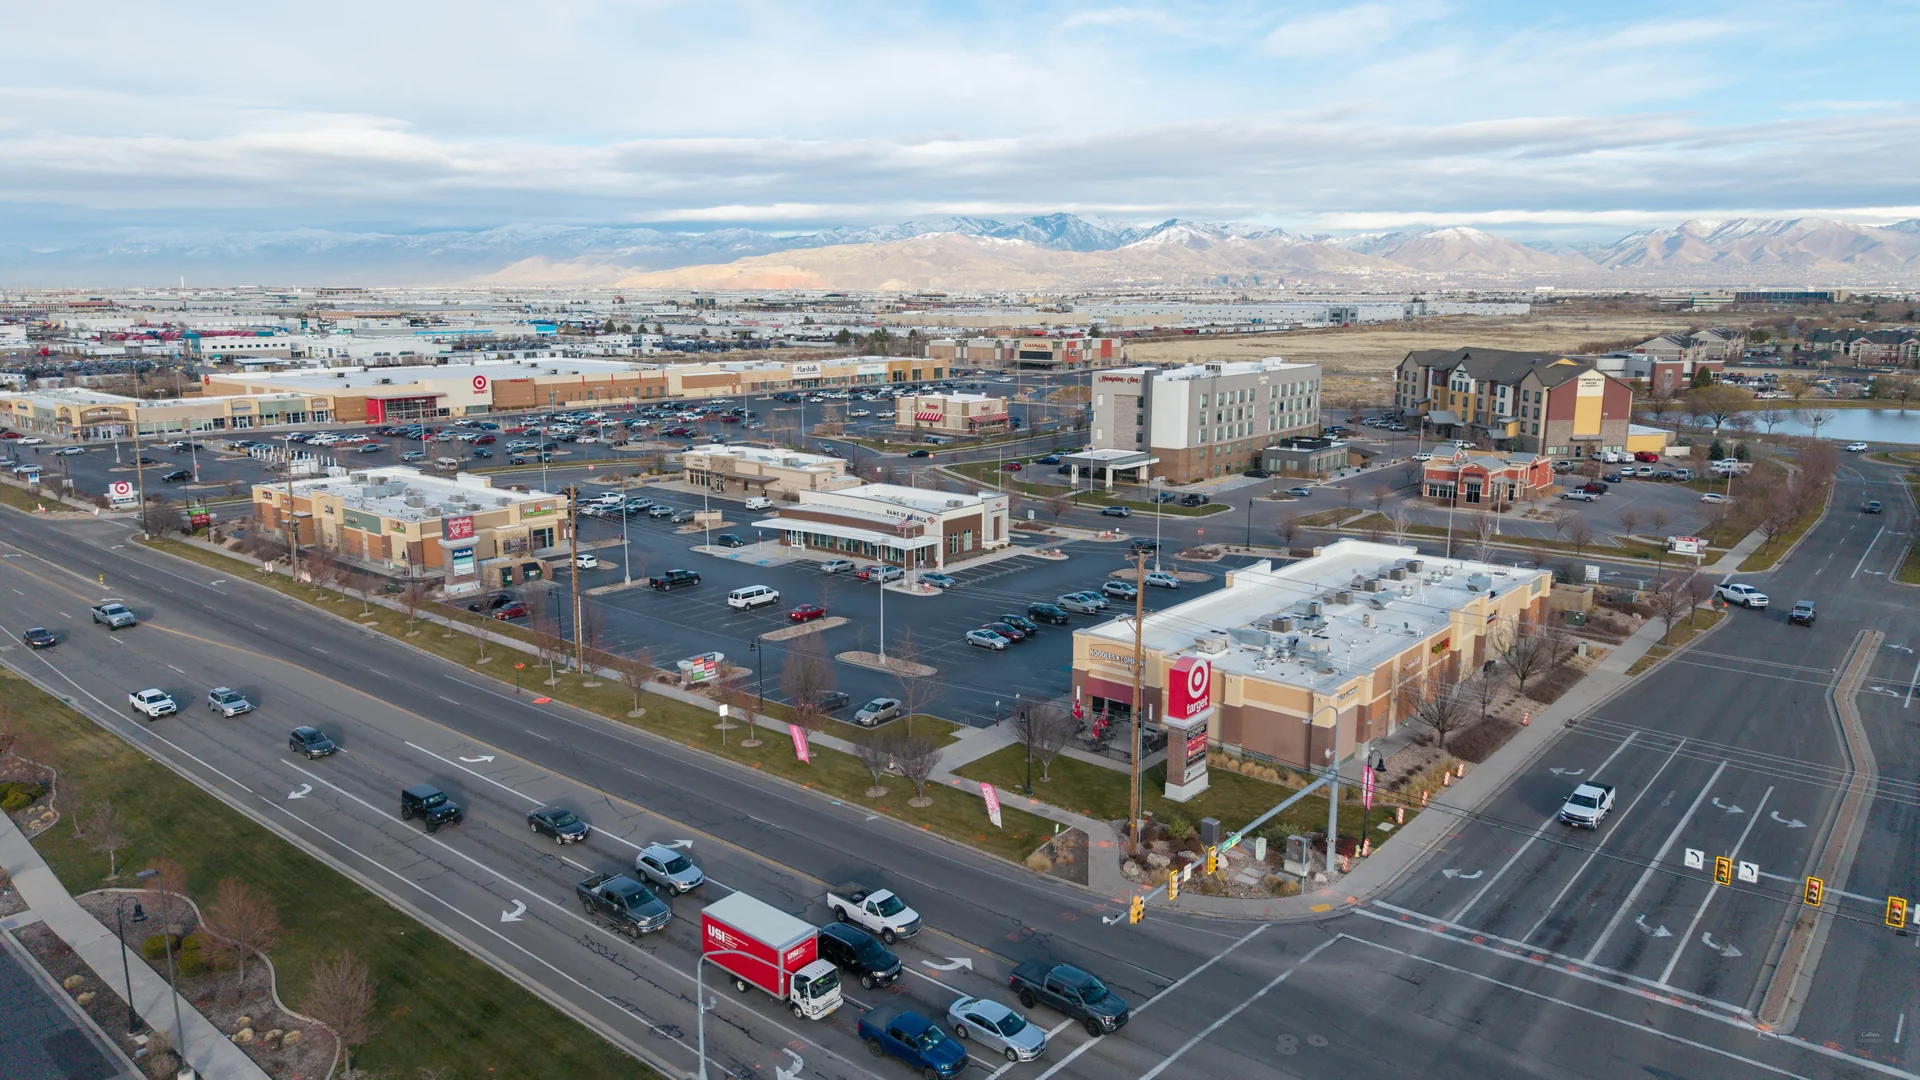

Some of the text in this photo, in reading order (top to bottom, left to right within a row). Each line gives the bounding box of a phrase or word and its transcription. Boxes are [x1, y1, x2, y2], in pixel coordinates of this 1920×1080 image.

[796, 364, 818, 373] Marshalls
[1098, 375, 1126, 384] Hampton
[886, 509, 900, 517] BANK
[1089, 649, 1116, 661] NOODLES
[1186, 694, 1208, 715] target
[707, 924, 725, 943] USI
[787, 948, 799, 960] USI
